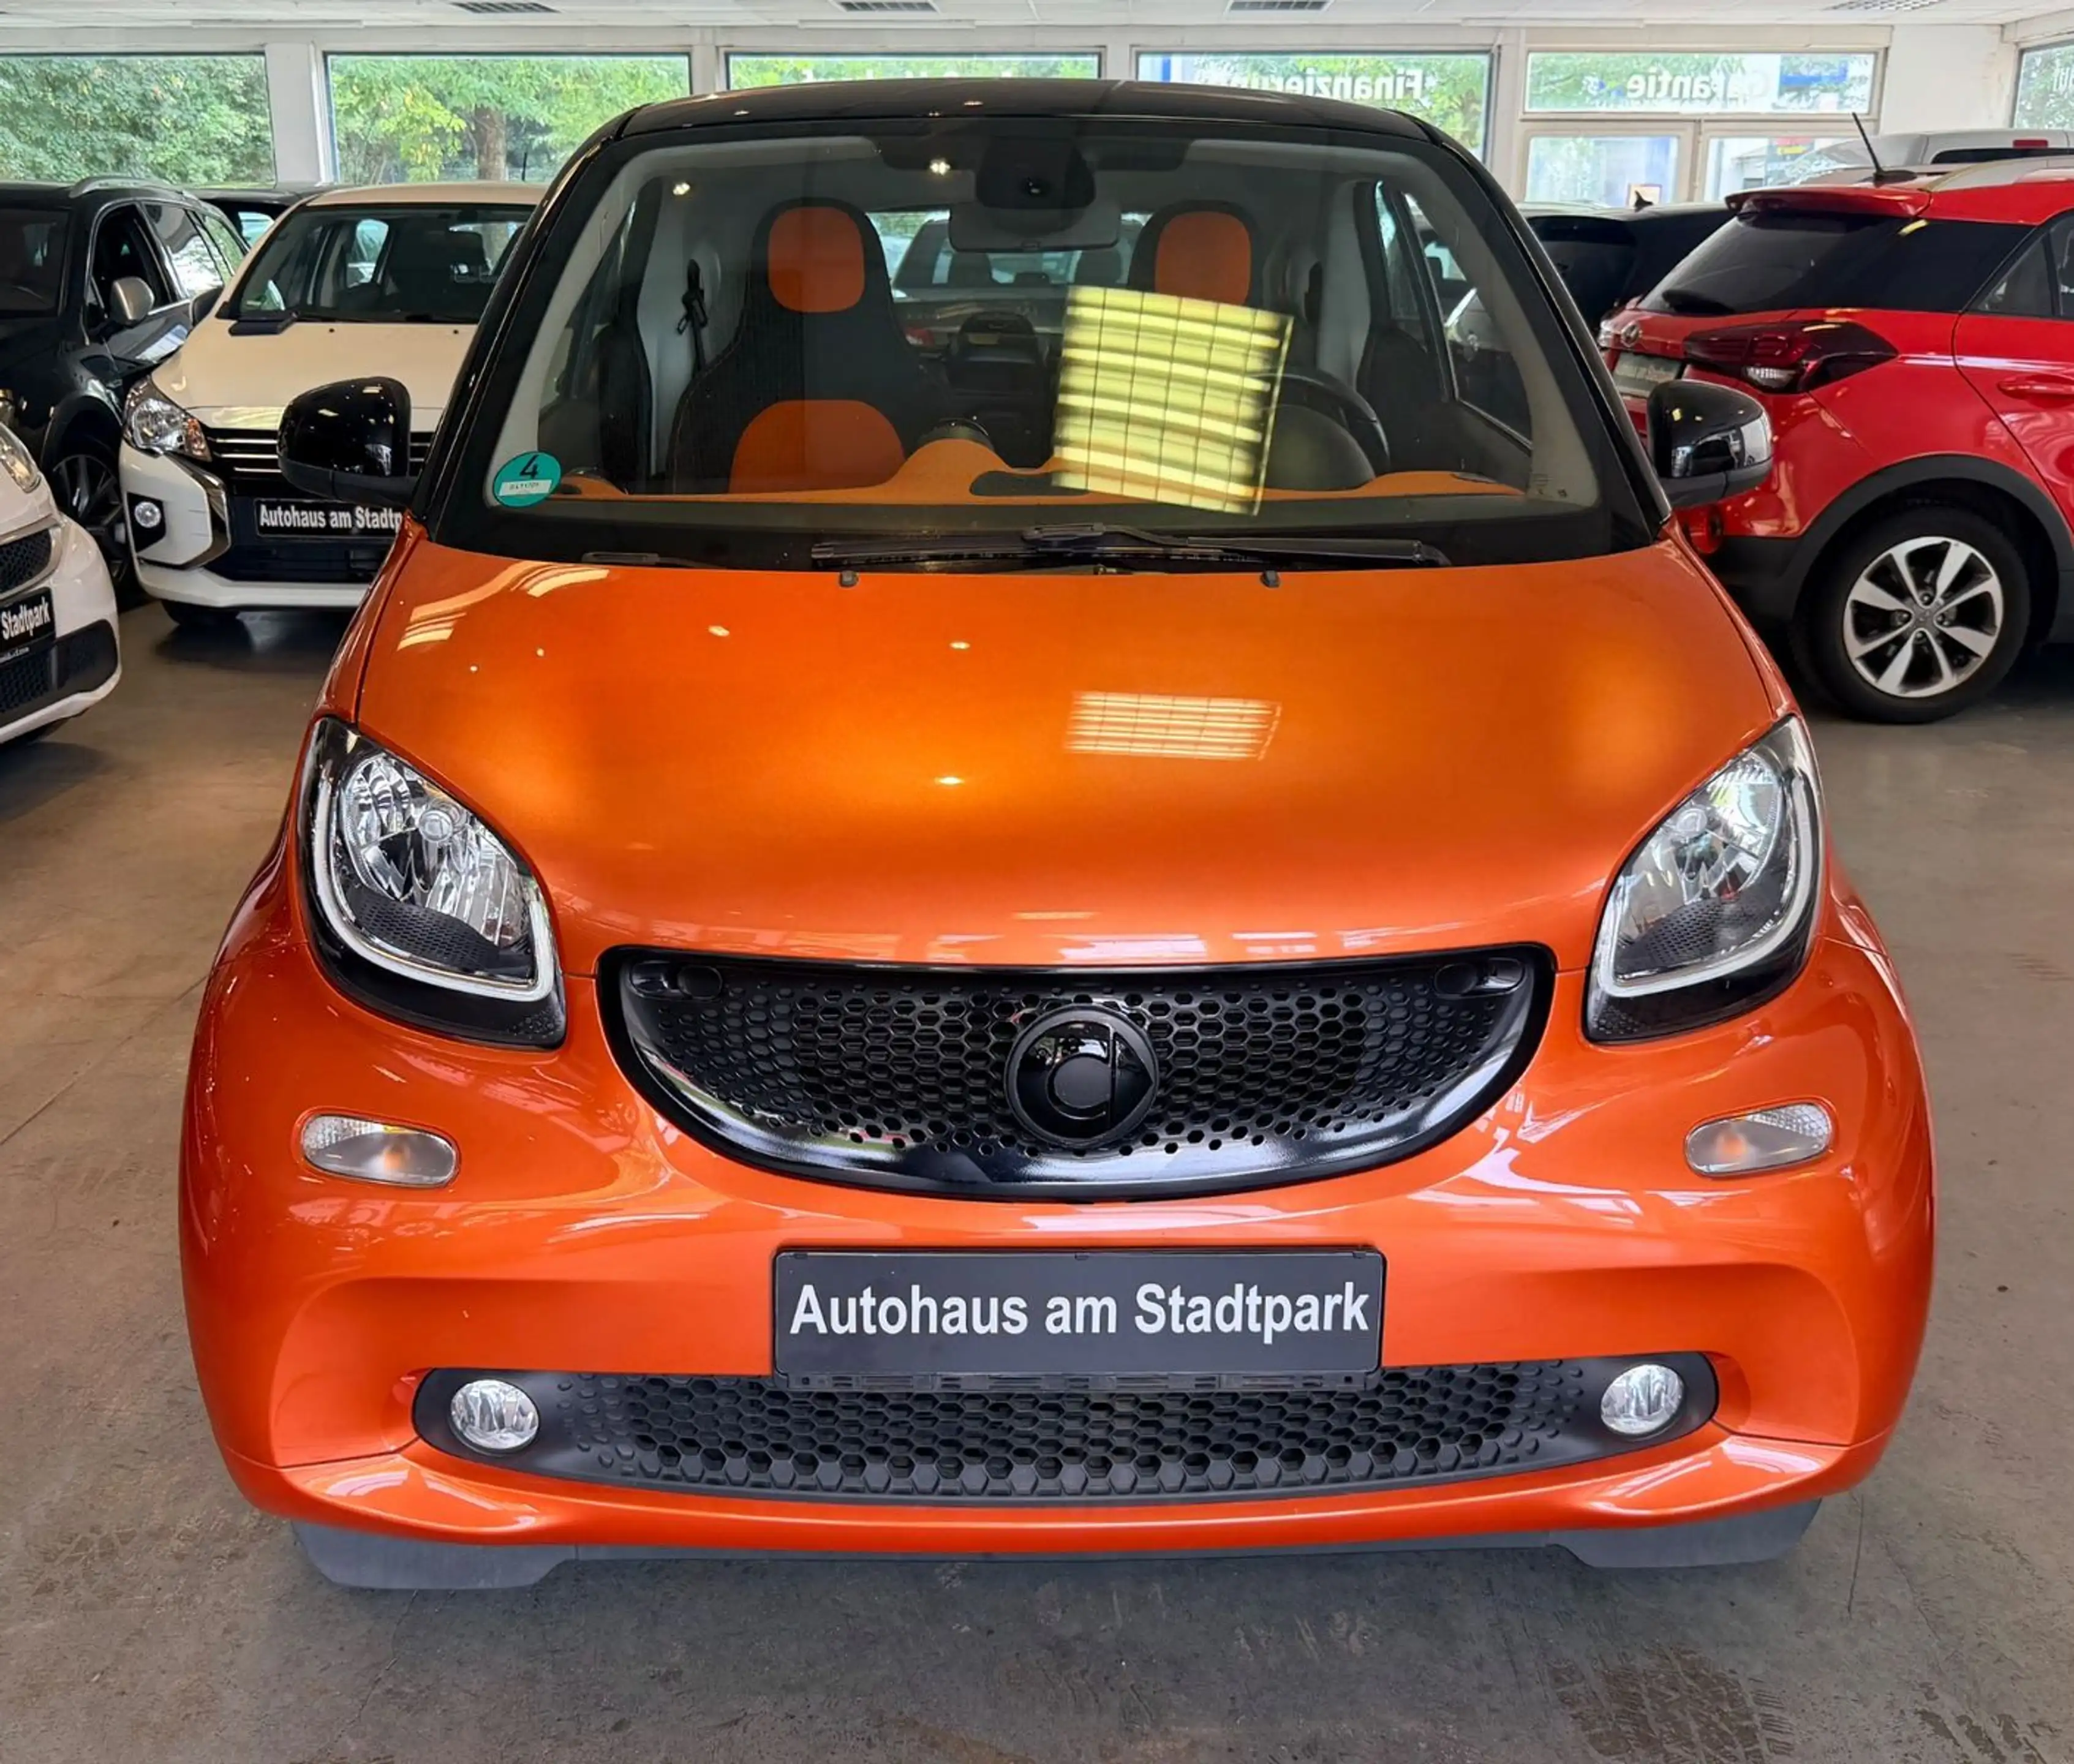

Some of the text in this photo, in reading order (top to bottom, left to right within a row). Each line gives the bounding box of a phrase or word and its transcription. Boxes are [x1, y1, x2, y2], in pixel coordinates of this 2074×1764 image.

[519, 454, 539, 480] 4
[260, 503, 326, 527] Autohaus
[330, 511, 352, 528] am
[1, 595, 51, 640] Stadtpark
[790, 1281, 1370, 1344] Autohaus am Stadtpark
